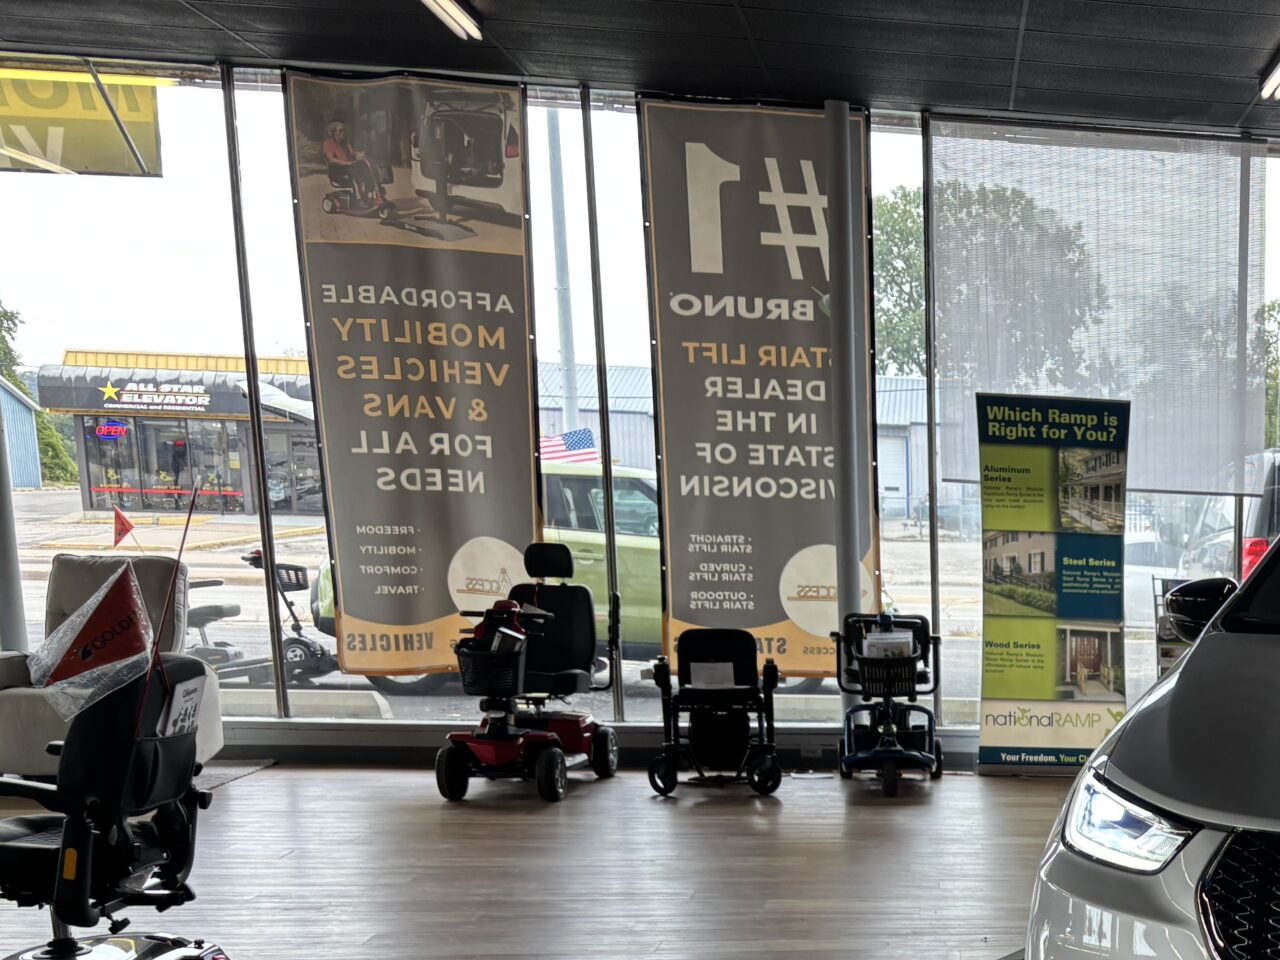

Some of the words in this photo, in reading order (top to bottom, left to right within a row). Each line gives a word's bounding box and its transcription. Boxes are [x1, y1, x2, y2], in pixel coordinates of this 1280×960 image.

[125, 382, 156, 392] ALL
[159, 383, 205, 393] STAR
[122, 394, 210, 405] ELEVATOR
[986, 405, 1042, 422] Which
[1048, 409, 1098, 428] Ramp
[1103, 412, 1118, 426] is
[96, 424, 128, 436] OPEN
[988, 422, 1036, 440] Right
[1041, 424, 1068, 440] for
[1073, 426, 1117, 442] You?
[983, 464, 1031, 474] Aluminum
[983, 474, 1012, 483] Series
[1062, 556, 1086, 566] Steel
[1088, 558, 1116, 568] Series
[985, 640, 1010, 649] Wood
[1013, 640, 1041, 650] Series
[1000, 753, 1019, 762] Your
[1021, 753, 1057, 762] Freedom.
[1059, 753, 1076, 763] Your
